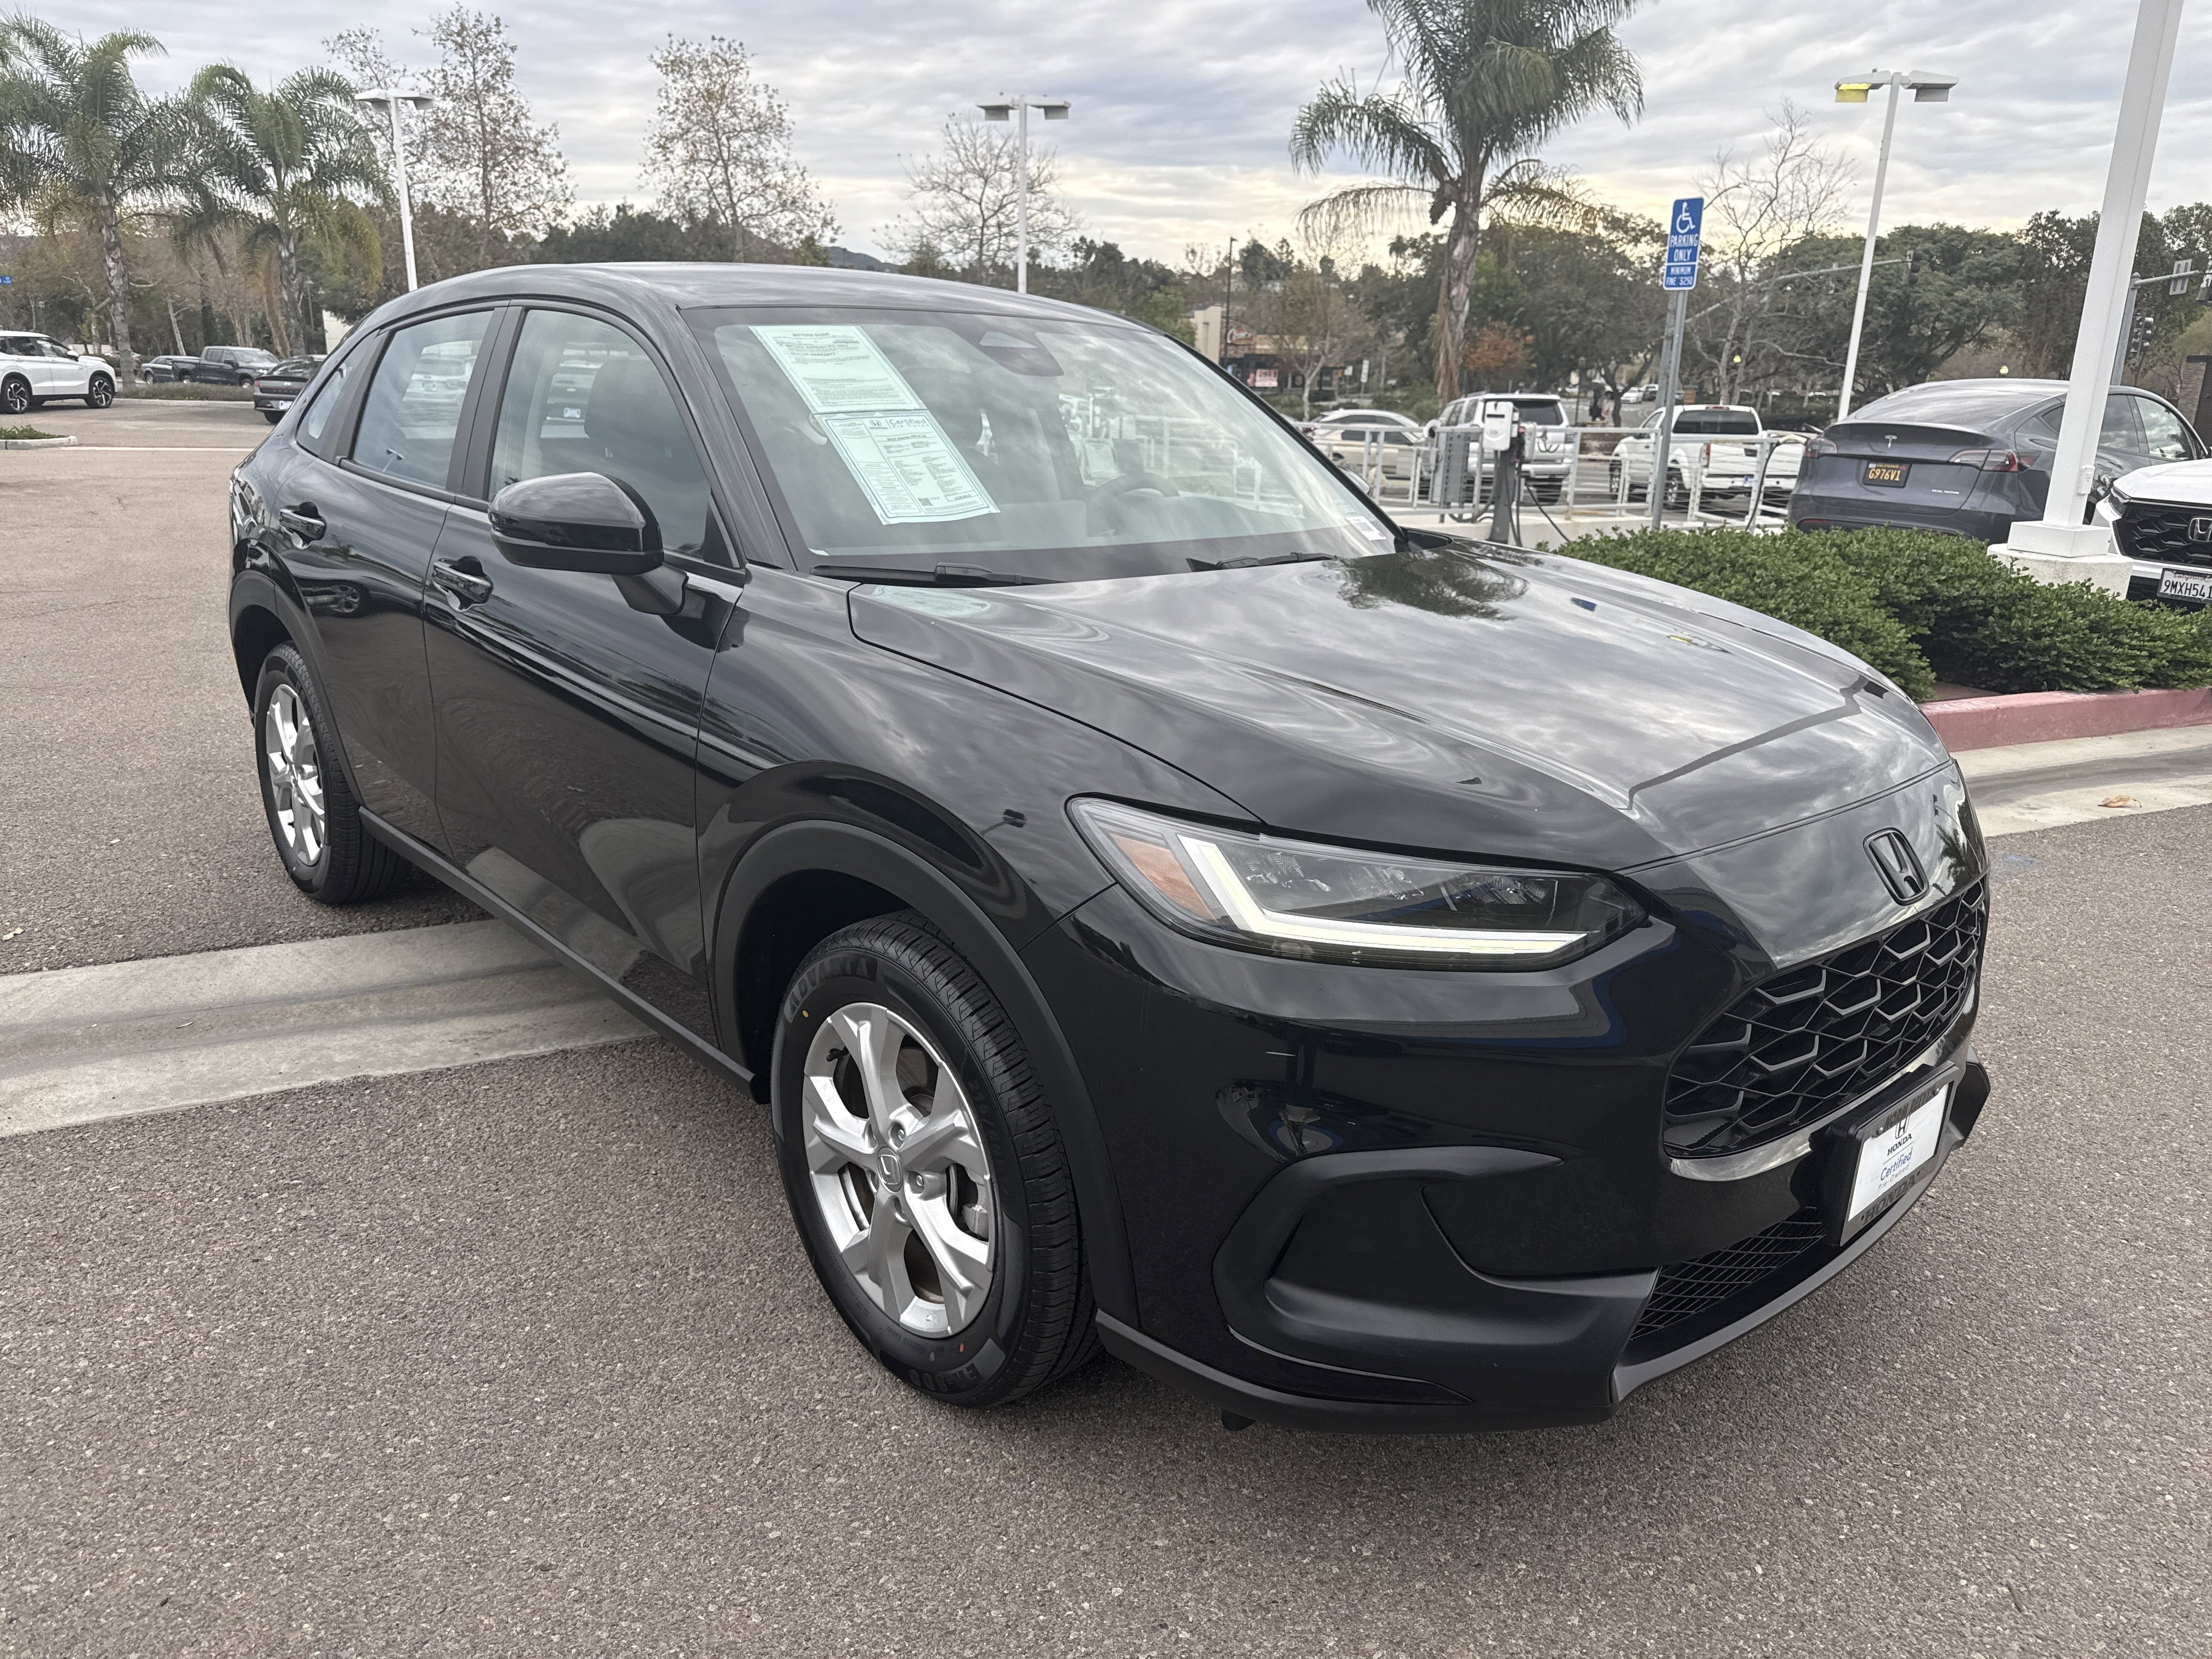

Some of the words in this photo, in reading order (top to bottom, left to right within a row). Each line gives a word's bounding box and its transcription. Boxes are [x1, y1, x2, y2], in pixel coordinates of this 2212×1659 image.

[1670, 234, 1699, 247] PARKING
[1674, 249, 1692, 262] ONLY
[1869, 469, 1901, 481] G976V1
[2163, 579, 2212, 599] 9MXH541
[1887, 1133, 1912, 1156] HONDA
[1881, 1147, 1913, 1181] Certified
[1863, 1175, 1916, 1226] HONDA
